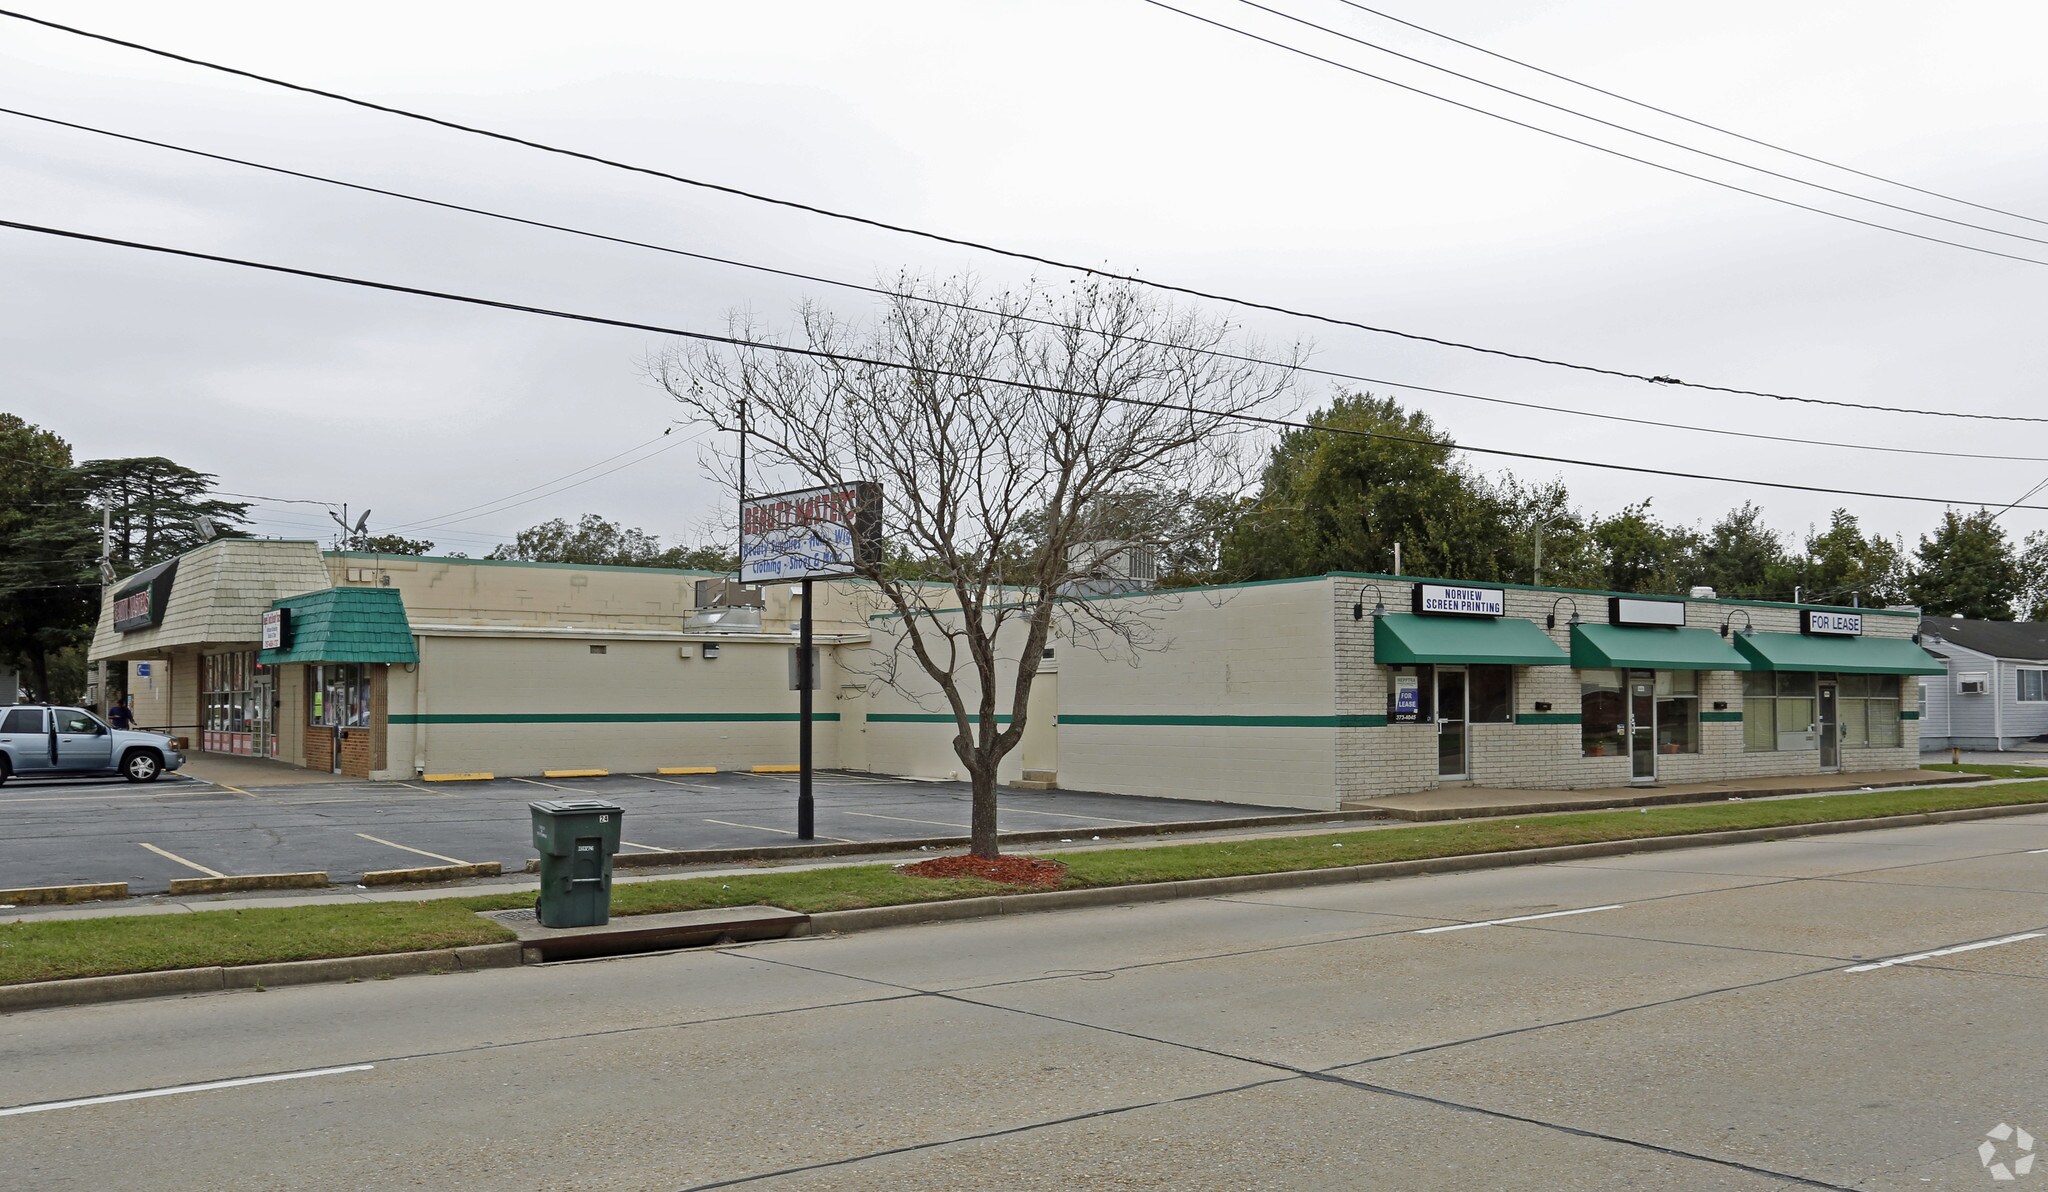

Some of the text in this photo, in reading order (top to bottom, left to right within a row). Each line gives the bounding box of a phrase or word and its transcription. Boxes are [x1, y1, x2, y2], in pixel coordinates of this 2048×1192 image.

[744, 499, 792, 535] BEAUTY
[743, 543, 768, 557] Beauty
[752, 560, 781, 575] Clothing
[813, 553, 820, 567] &
[1445, 588, 1482, 601] NORVIEW
[1426, 598, 1500, 613] SCREEN PRINTING
[1812, 615, 1859, 631] FOR LEASE
